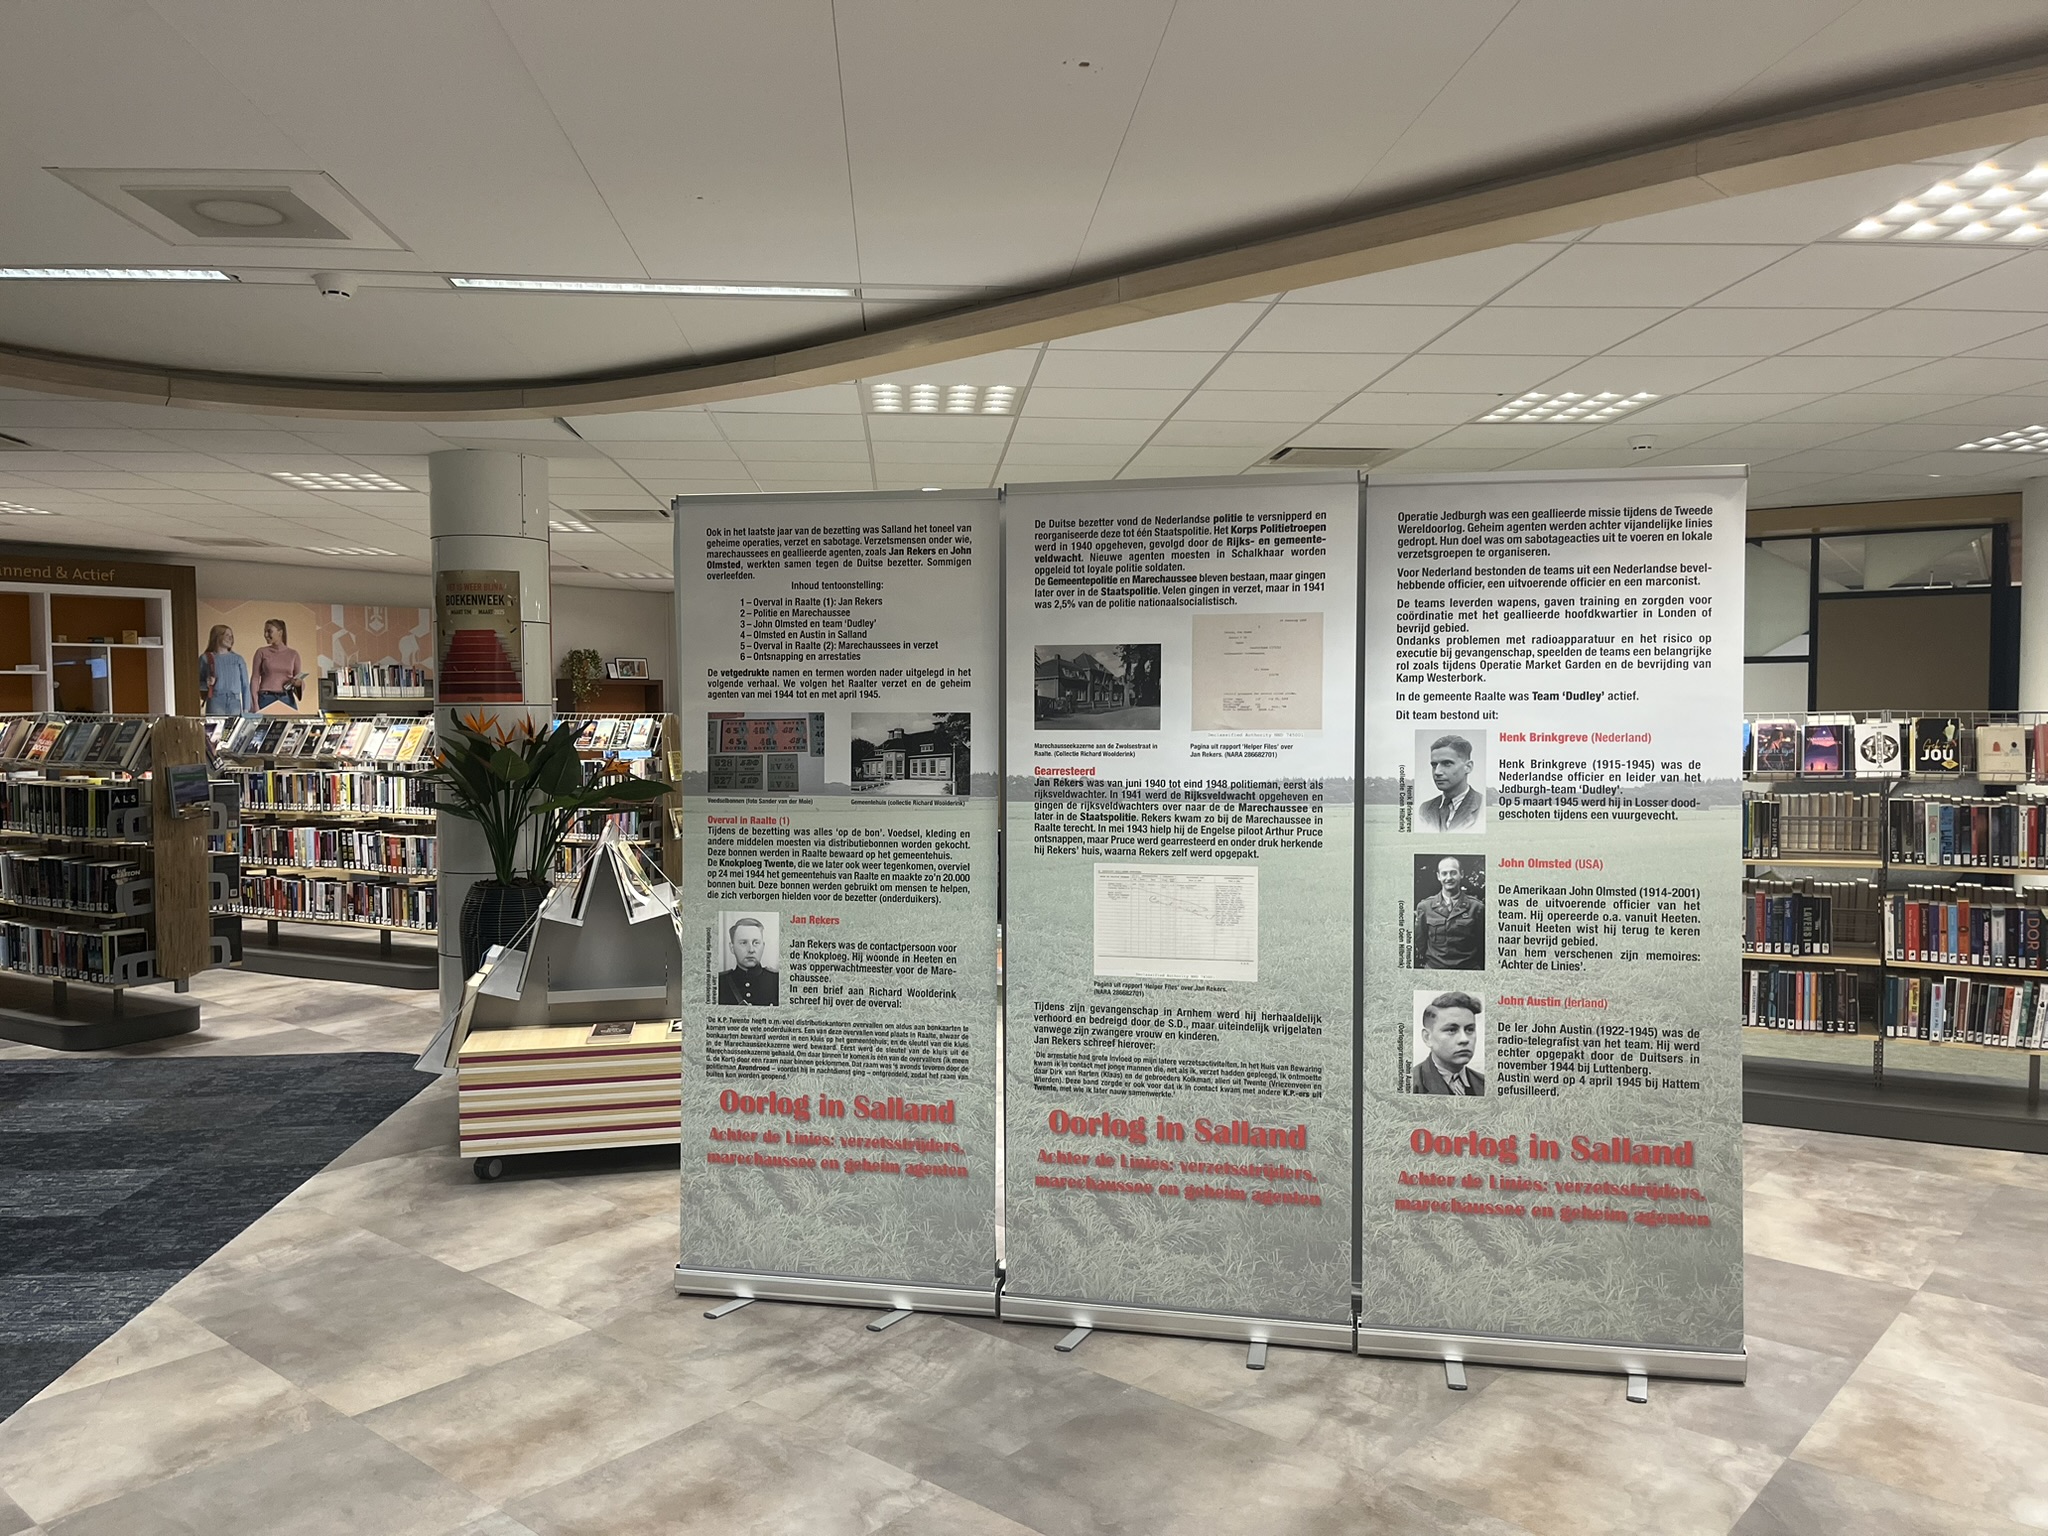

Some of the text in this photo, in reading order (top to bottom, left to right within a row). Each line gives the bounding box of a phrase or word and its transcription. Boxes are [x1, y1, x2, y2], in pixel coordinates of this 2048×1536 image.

[1034, 519, 1045, 528] De
[1048, 518, 1075, 528] Duitse
[1078, 516, 1113, 526] bezetter
[1116, 515, 1138, 525] vond
[1140, 515, 1151, 525] de
[1154, 513, 1210, 524] Nederlandse
[1213, 512, 1242, 525] politie
[1245, 512, 1254, 522] te
[1257, 510, 1312, 524] versnipperd
[1397, 510, 1438, 523] Operatie
[1440, 510, 1486, 522] Jedburgh
[1531, 508, 1586, 521] geallieerde
[1588, 508, 1620, 517] missie
[1623, 507, 1657, 519] tijdens
[1659, 506, 1672, 516] de
[1675, 506, 1712, 516] Tweede
[706, 527, 722, 536] Ook
[723, 527, 731, 536] in
[732, 526, 746, 536] het
[747, 526, 775, 535] laatste
[776, 526, 792, 537] jaar
[811, 525, 821, 534] de
[823, 525, 860, 537] bezetting
[881, 524, 912, 534] Salland
[913, 524, 927, 533] het
[929, 524, 954, 533] toneel
[56, 566, 68, 579] &
[72, 568, 116, 581] Actief
[791, 580, 883, 592] Inhoud tentoonstelling:
[446, 594, 505, 606] BOEKENWEEK
[1395, 710, 1498, 719] Dit team bestond uit:
[1499, 732, 1652, 745] Henk Brinkgreve (Nederland)
[1920, 749, 1953, 761] JOU
[1034, 766, 1096, 775] Gearresteerd
[707, 815, 738, 824] Overval
[749, 816, 777, 824] Raalte
[780, 816, 790, 826] (1)
[708, 826, 735, 837] Tijdens
[738, 826, 748, 835] de
[751, 826, 790, 838] bezetting
[813, 827, 832, 836] alles
[851, 828, 861, 836] de
[887, 828, 922, 840] Voedsel,
[925, 829, 956, 840] kleding
[1499, 858, 1604, 871] John Olmsted (USA)
[790, 915, 839, 924] Jan Rekers
[1497, 995, 1524, 1005] John
[1527, 996, 1561, 1006] Austin
[1497, 1022, 1510, 1032] De
[1514, 1022, 1528, 1032] Ier
[1530, 1023, 1556, 1033] John
[1559, 1024, 1592, 1035] Austin
[1595, 1025, 1657, 1039] (1922-1945)
[1687, 1028, 1699, 1038] de
[719, 1089, 954, 1123] Oorlog in Salland
[1048, 1110, 1305, 1150] Oorlog in Salland
[710, 1127, 965, 1155] Achter de Linies: verzetsstrijders,
[1410, 1129, 1692, 1166] Oorlog in Salland
[707, 1150, 967, 1179] marechaussee en geheim agenten
[1039, 1149, 1317, 1183] Achter de Linies: verzetsstrijders,
[1035, 1173, 1320, 1207] marechaussee en geheim agenten
[1399, 1170, 1706, 1202] Achter de Linies: verzetsstrijders,
[1394, 1196, 1709, 1228] marechaussee en geheim agenten
